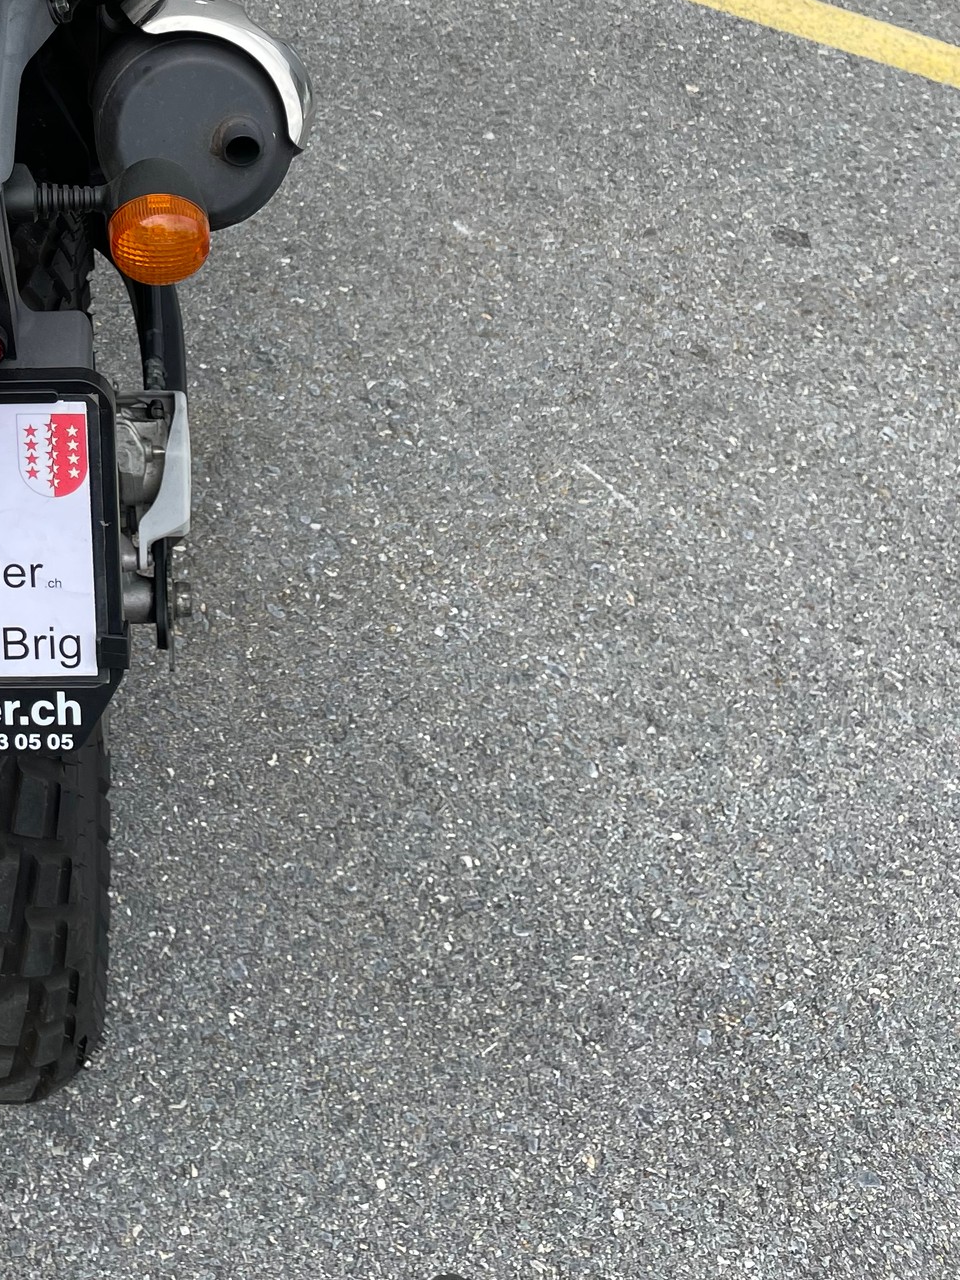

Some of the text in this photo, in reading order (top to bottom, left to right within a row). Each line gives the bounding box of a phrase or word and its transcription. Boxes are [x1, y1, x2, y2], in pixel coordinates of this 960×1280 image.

[2, 626, 82, 670] Brig
[14, 733, 42, 750] 05
[46, 733, 74, 750] 05
